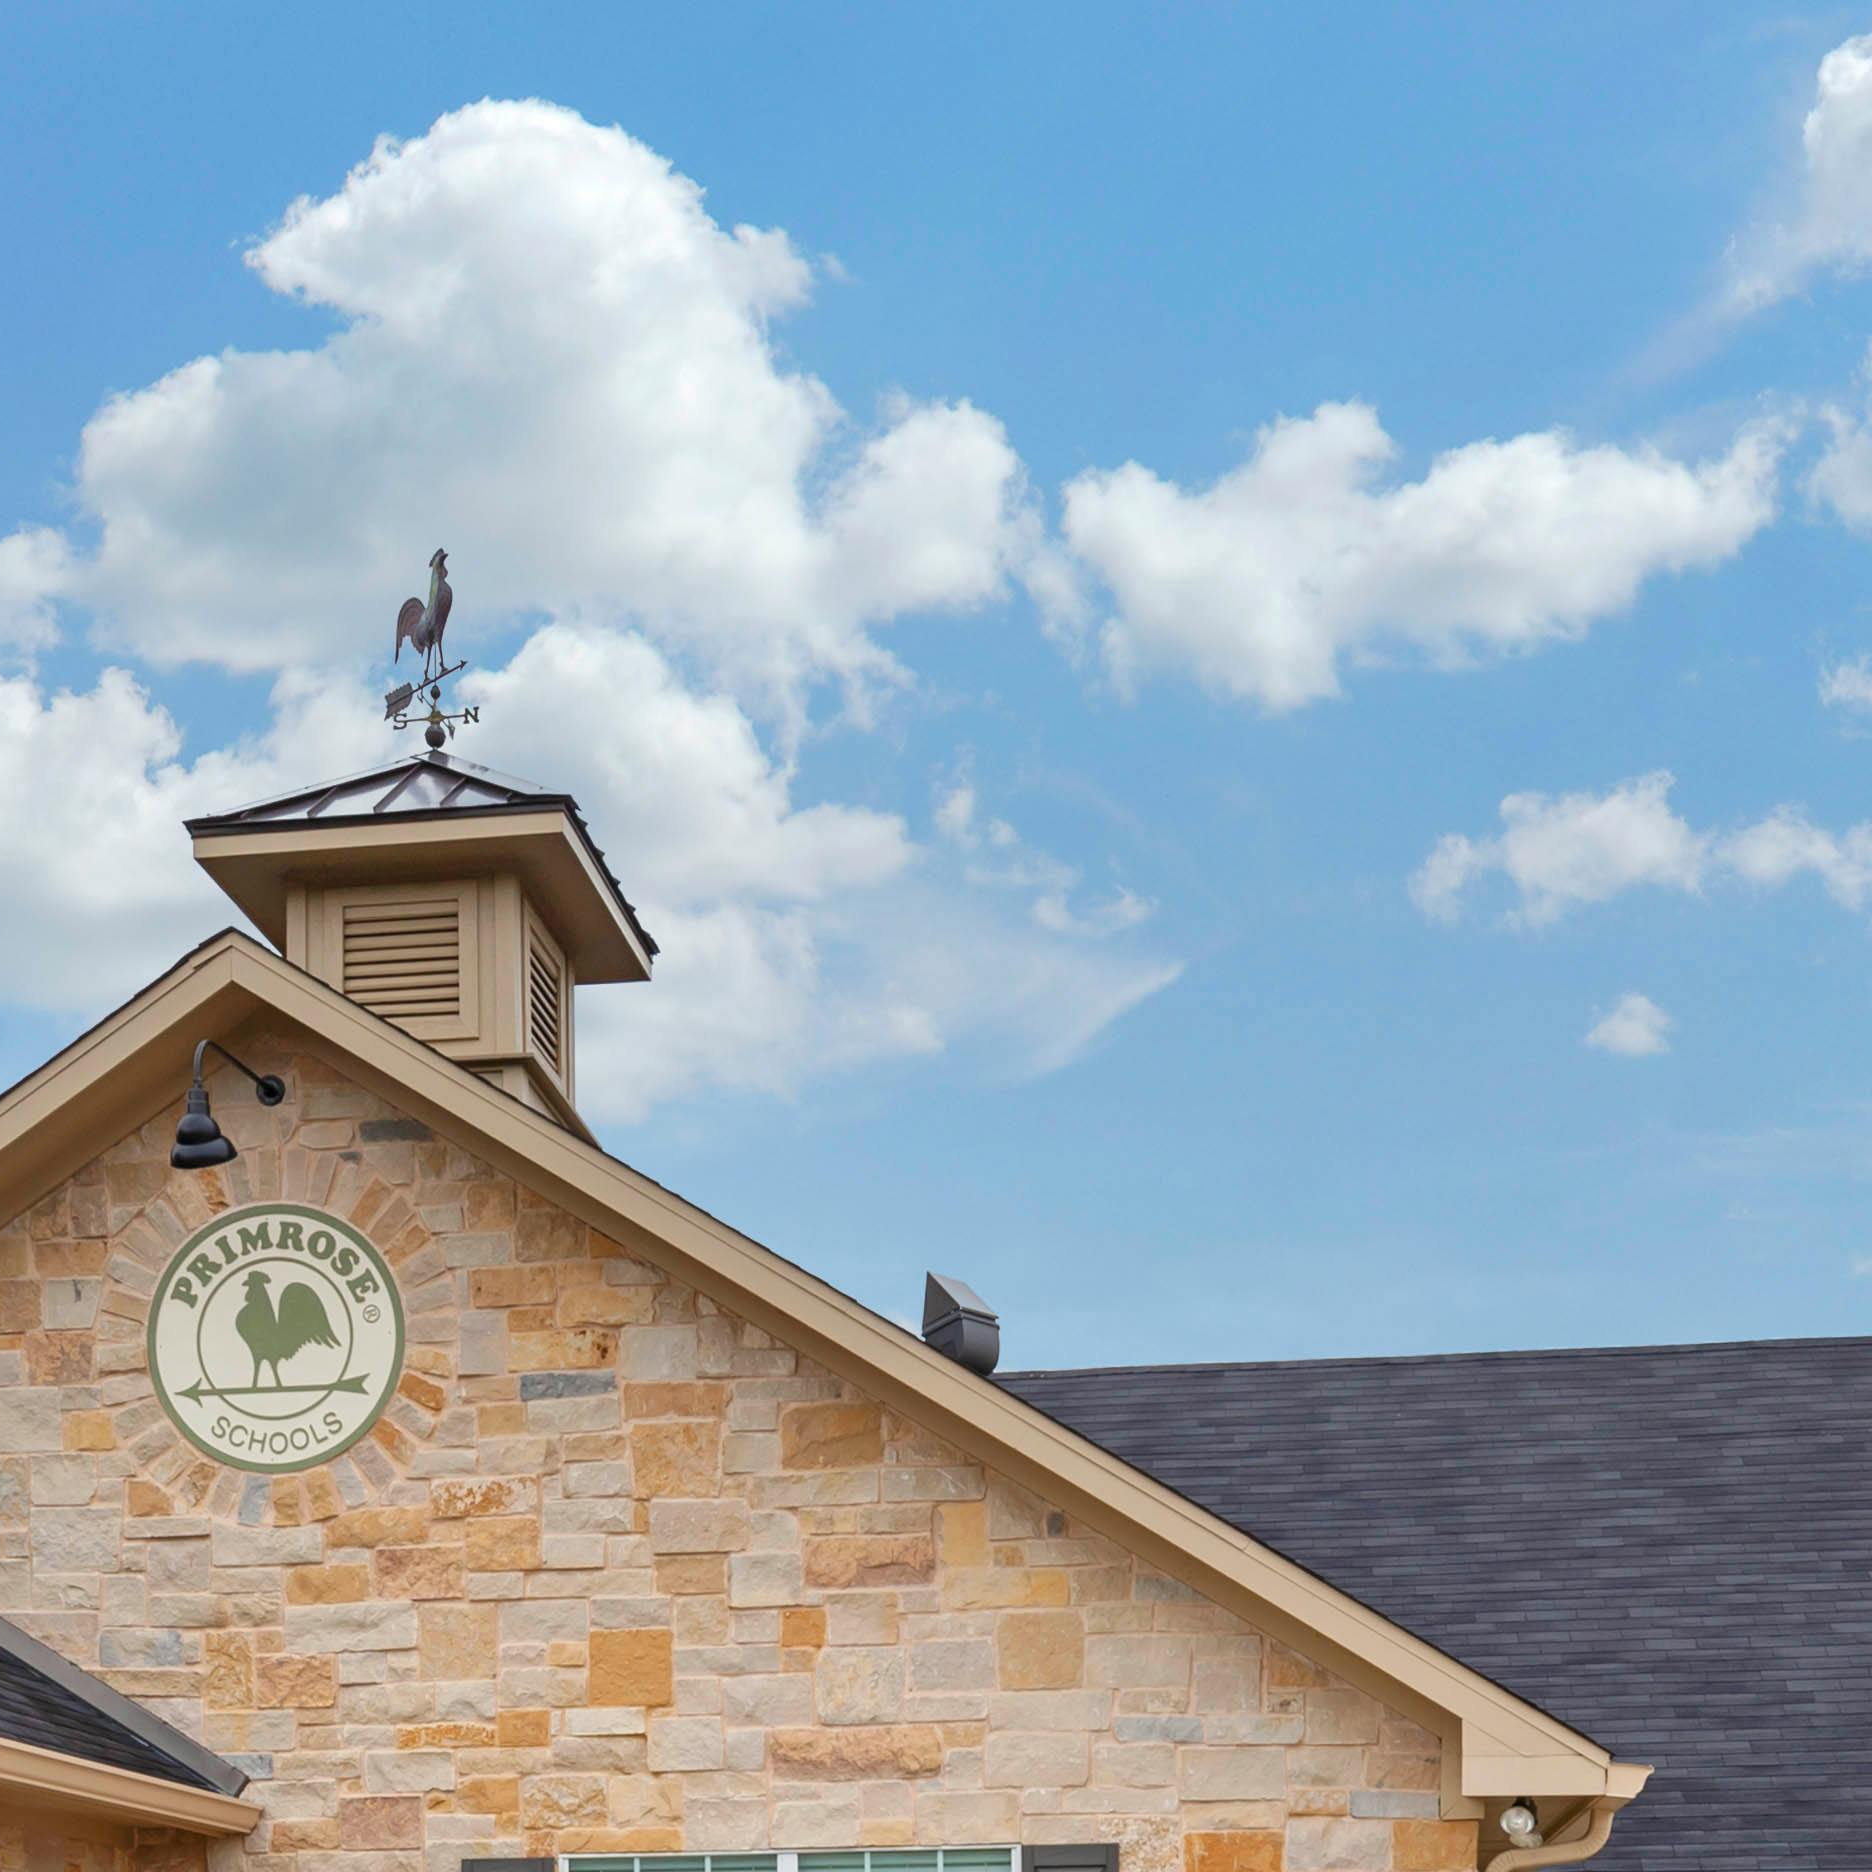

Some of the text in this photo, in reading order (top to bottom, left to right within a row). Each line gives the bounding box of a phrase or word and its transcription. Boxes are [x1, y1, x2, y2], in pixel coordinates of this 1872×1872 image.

[463, 706, 480, 724] N
[170, 1220, 381, 1309] PRIMROSE
[211, 1411, 344, 1455] SCHOOLS
